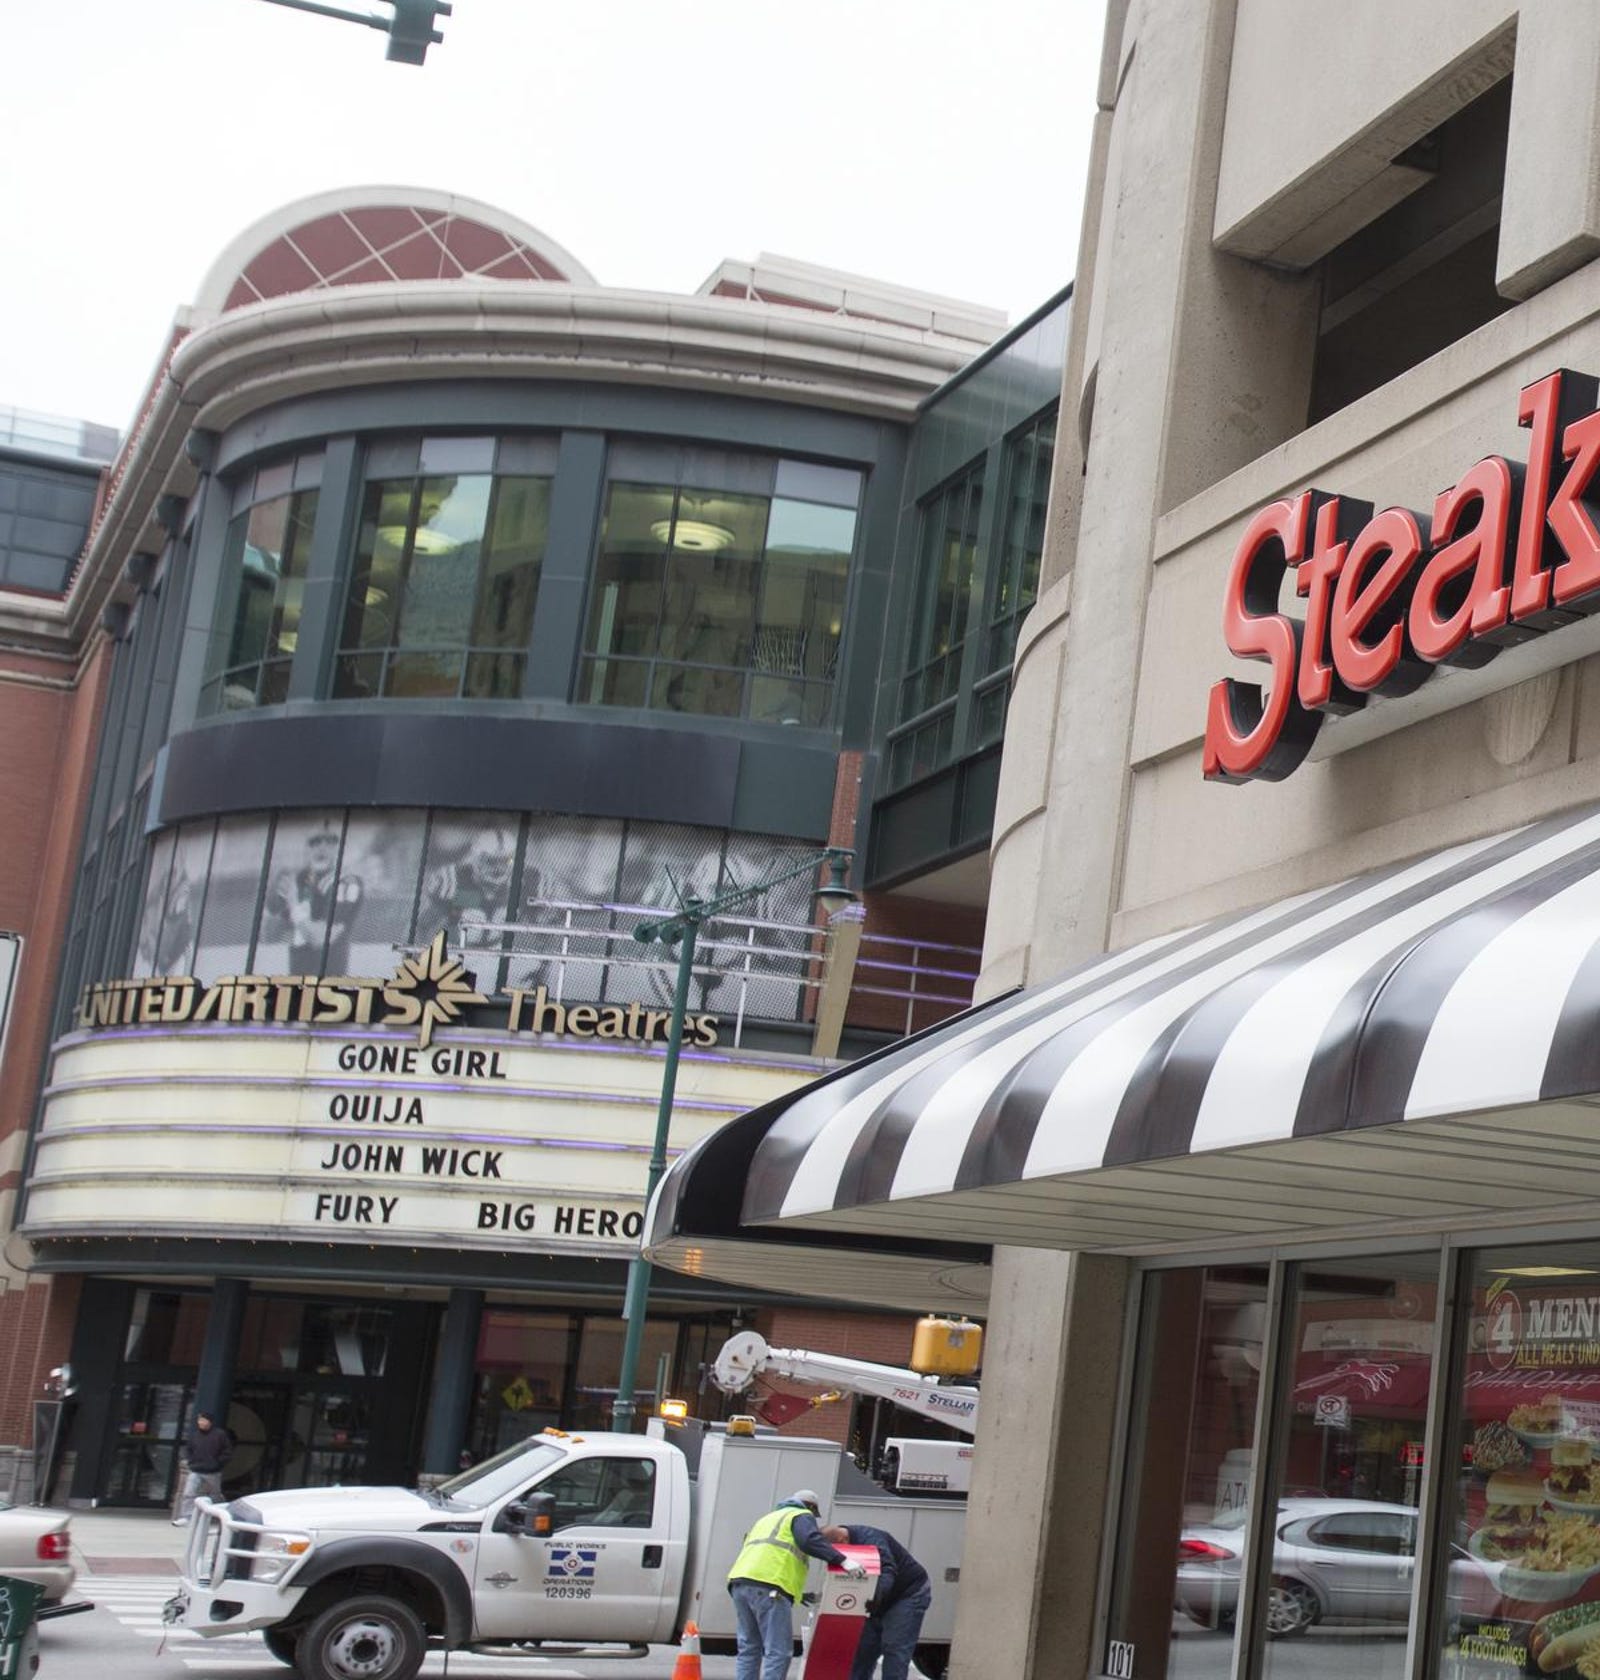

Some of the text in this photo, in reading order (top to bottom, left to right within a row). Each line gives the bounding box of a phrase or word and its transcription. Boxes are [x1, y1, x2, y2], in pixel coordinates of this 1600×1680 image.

[194, 975, 422, 1025] ARTISTS
[338, 1045, 507, 1079] GONE GIRL
[329, 1094, 424, 1124] OUIJA
[321, 1143, 504, 1178] JOHN WICK
[315, 1194, 644, 1238] FURY BIG HERO
[1516, 1344, 1539, 1366] ALL
[1541, 1344, 1575, 1366] MEALS
[894, 1387, 920, 1401] 7621
[928, 1394, 975, 1411] STELLAR
[544, 1587, 592, 1599] 120396
[1112, 1642, 1133, 1676] 101
[1471, 1639, 1527, 1665] FOOTLONGS!
